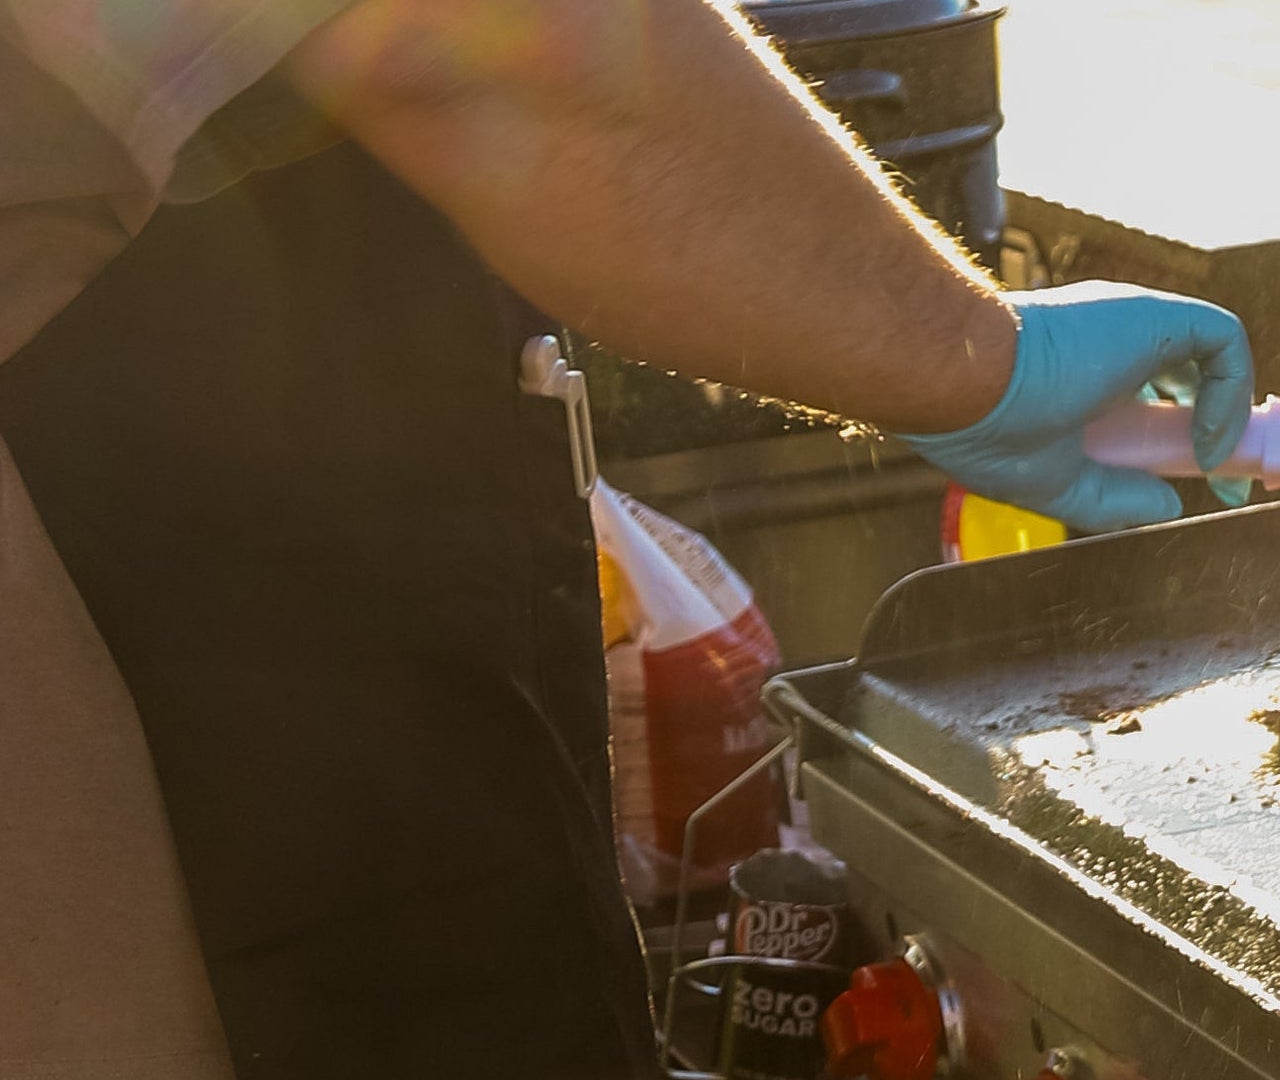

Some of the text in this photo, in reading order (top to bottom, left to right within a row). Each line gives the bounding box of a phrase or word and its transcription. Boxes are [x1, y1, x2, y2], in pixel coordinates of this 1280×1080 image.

[743, 906, 831, 958] Pepper
[768, 904, 808, 933] Dr
[736, 979, 818, 1018] zero
